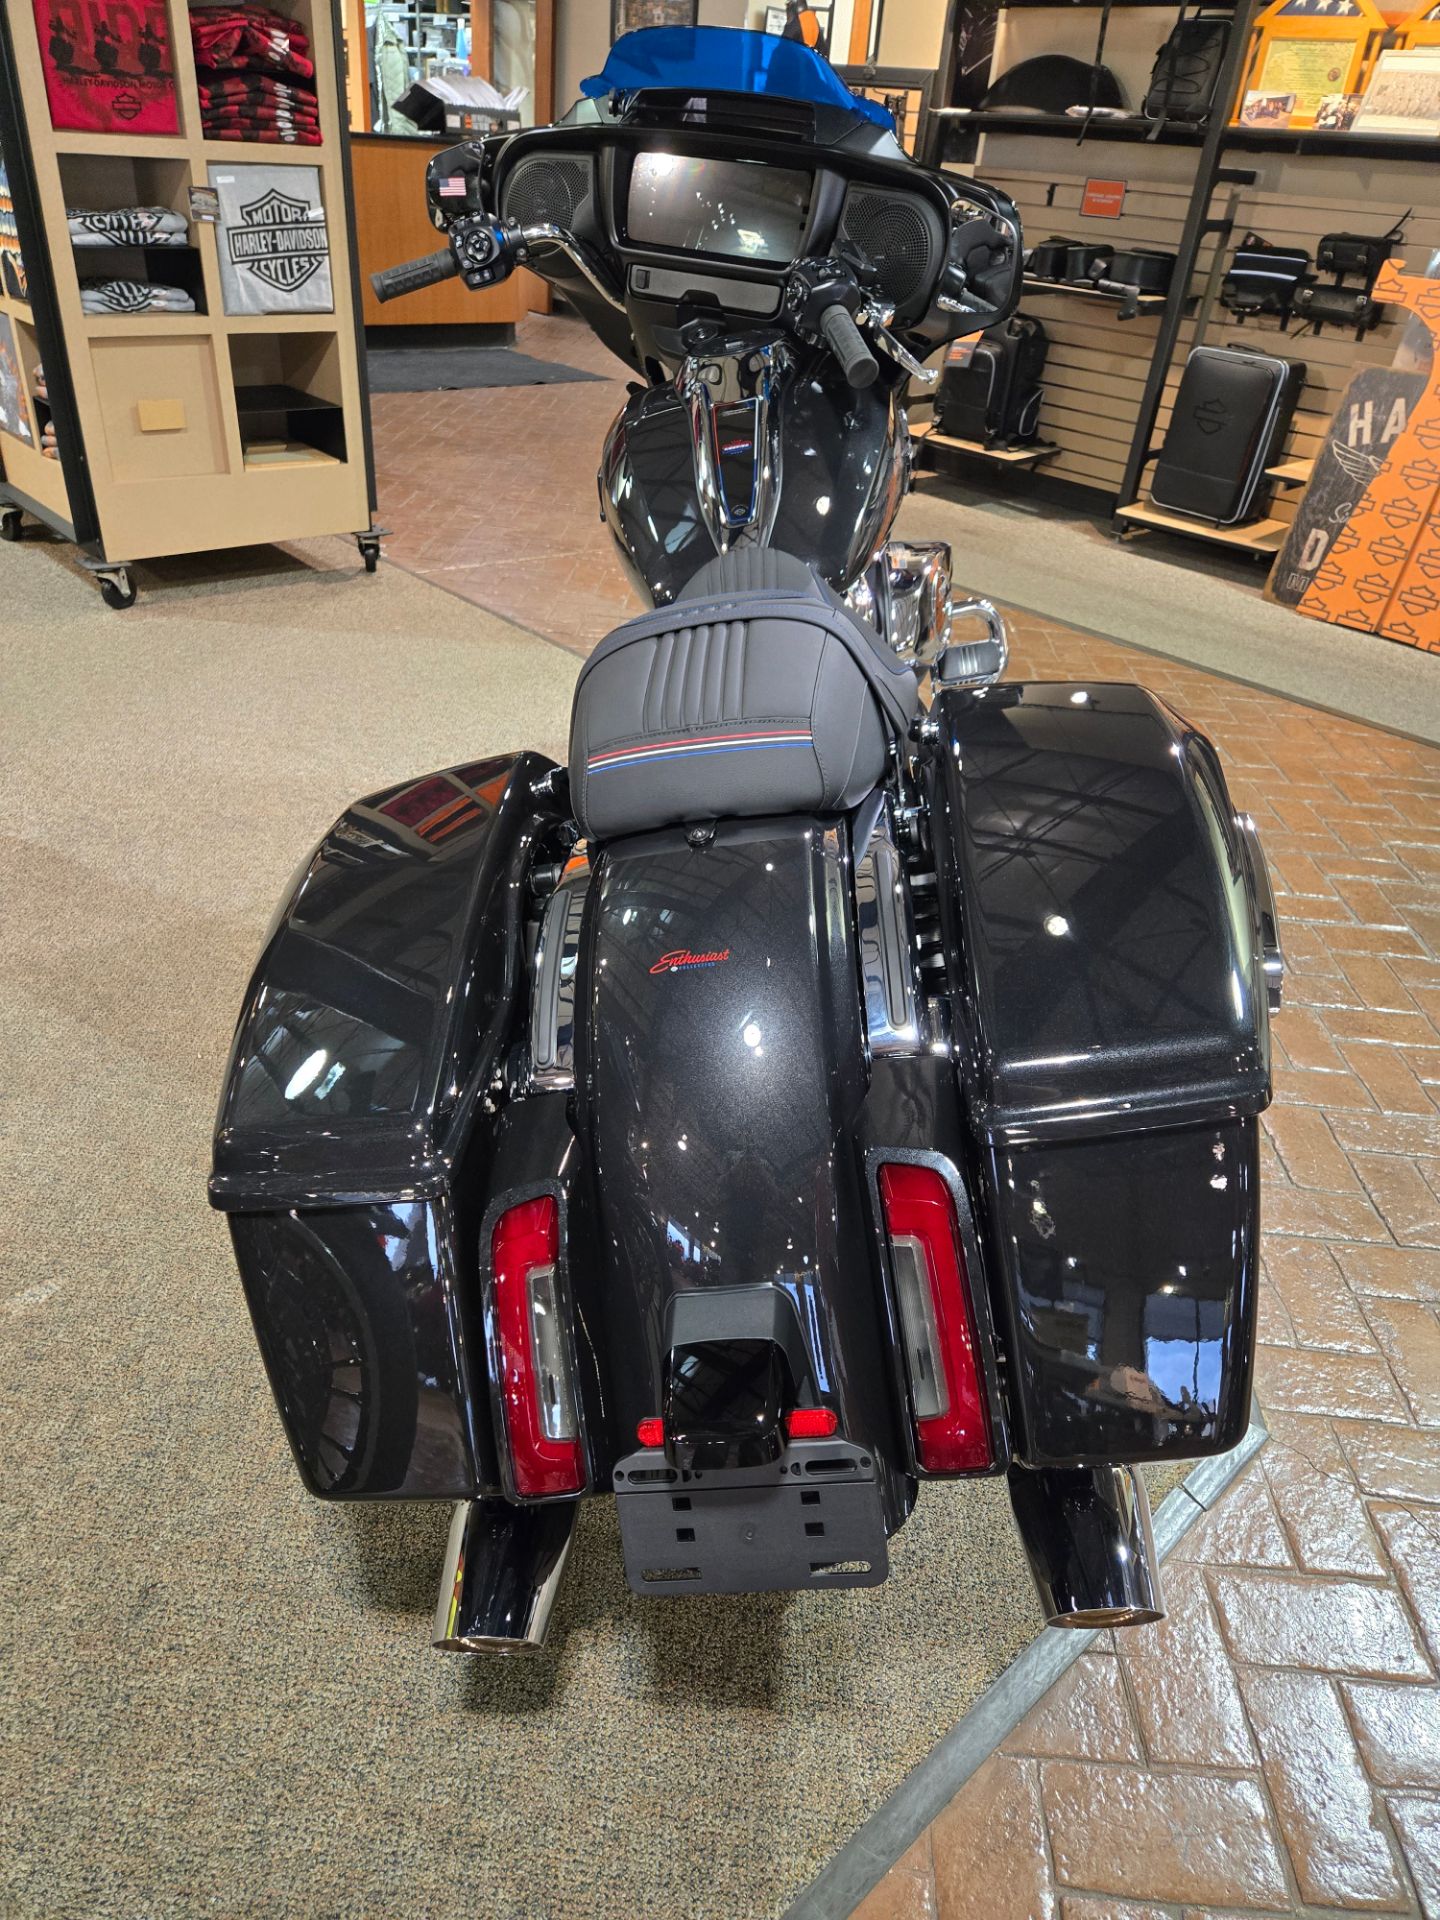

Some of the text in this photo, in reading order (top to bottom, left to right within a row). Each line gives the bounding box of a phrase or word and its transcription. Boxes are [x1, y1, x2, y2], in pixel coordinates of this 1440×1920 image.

[251, 199, 302, 225] MOTOR
[234, 228, 328, 256] HARLEY-DAVIDSON
[260, 256, 310, 285] CYCLES
[649, 948, 730, 974] Enthusiast
